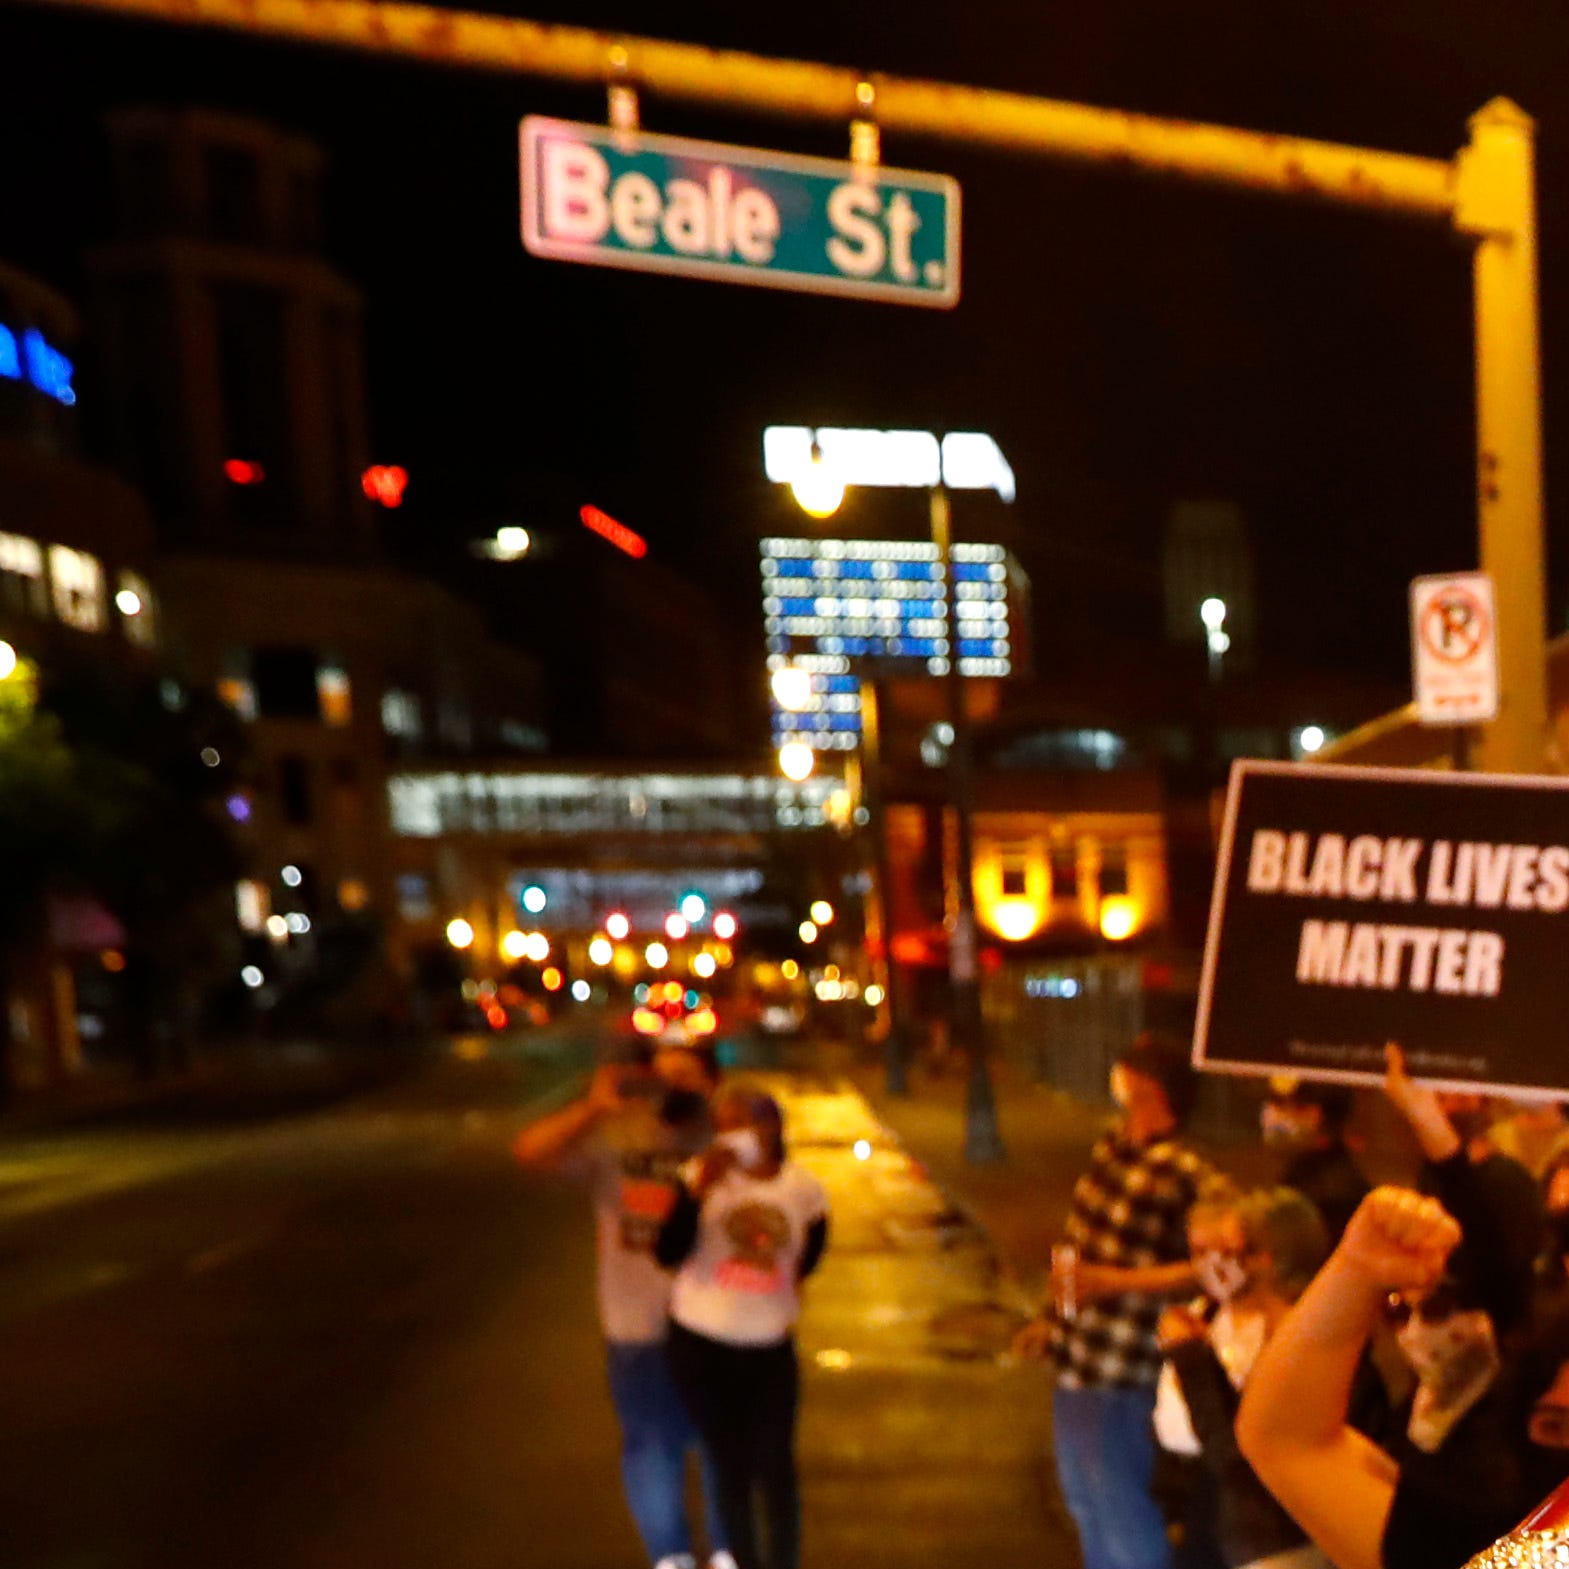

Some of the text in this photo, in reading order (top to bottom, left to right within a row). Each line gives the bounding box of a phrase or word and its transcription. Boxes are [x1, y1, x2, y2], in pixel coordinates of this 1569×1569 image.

[542, 140, 946, 287] Beale St.
[1247, 828, 1424, 904] BLACK
[1295, 919, 1506, 996] MATTER
